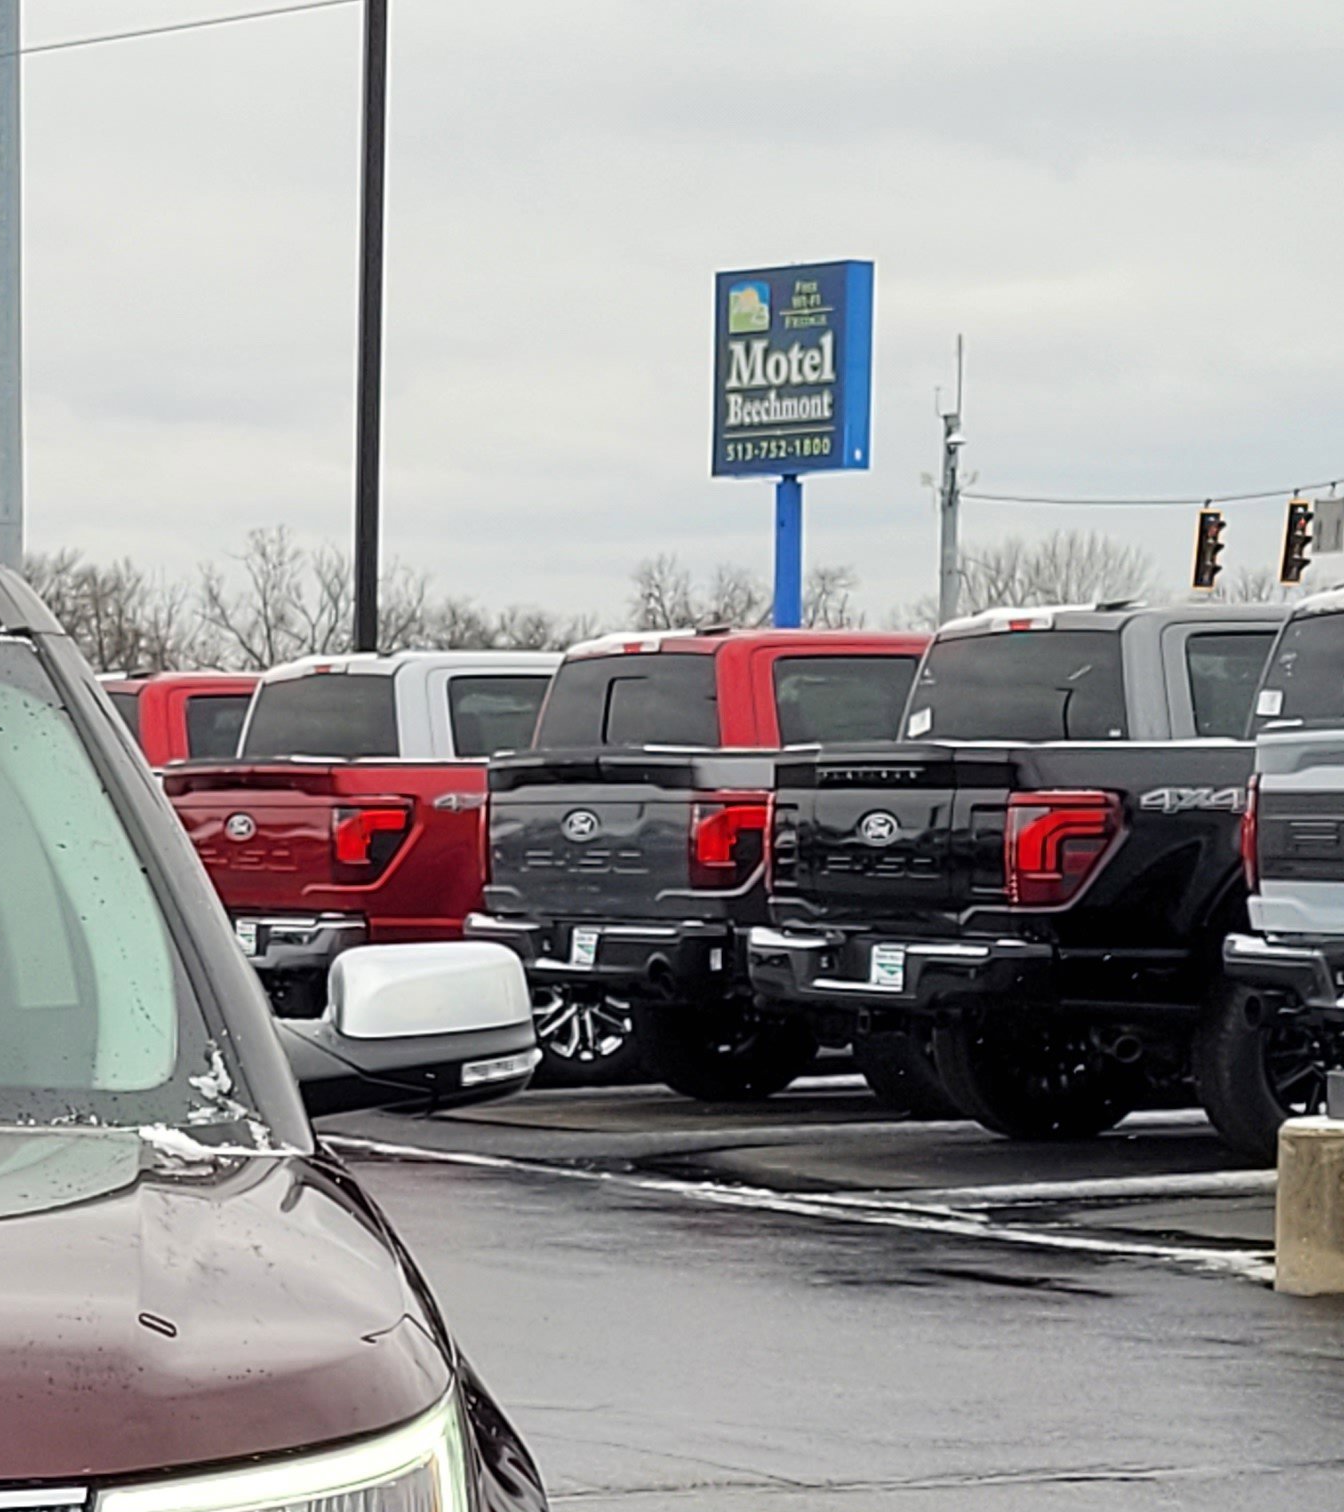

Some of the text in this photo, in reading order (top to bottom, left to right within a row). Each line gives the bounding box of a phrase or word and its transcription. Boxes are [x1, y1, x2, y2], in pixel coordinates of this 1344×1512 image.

[725, 330, 836, 388] Motel
[725, 388, 833, 426] Beechmont
[725, 437, 831, 461] 513-752-1800
